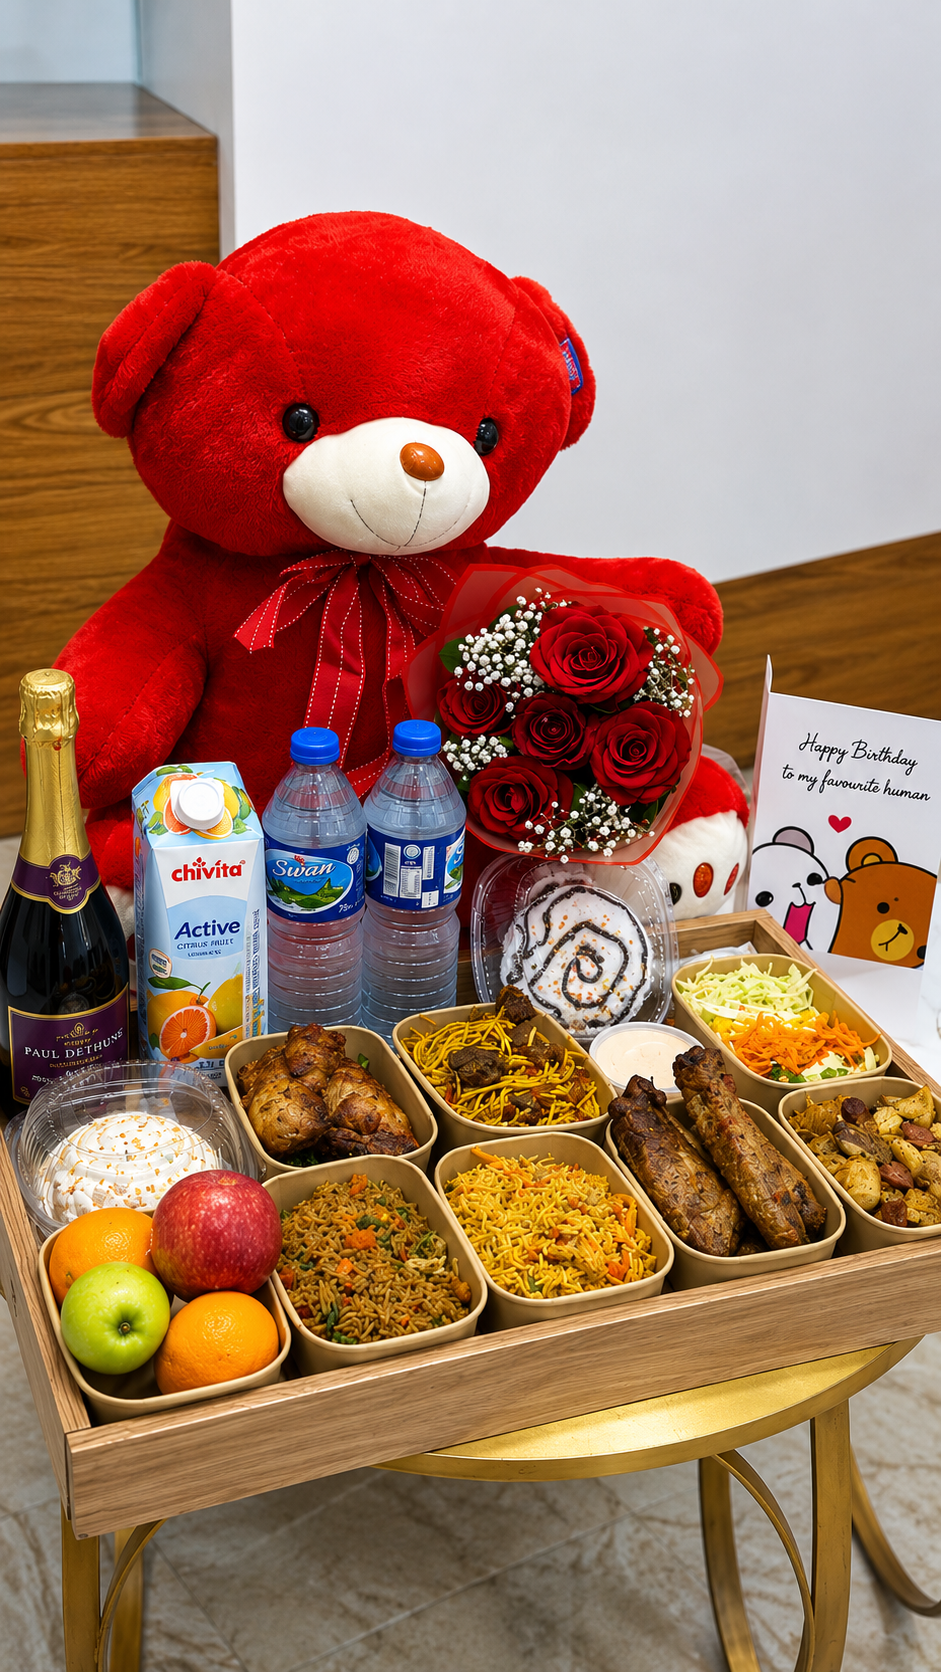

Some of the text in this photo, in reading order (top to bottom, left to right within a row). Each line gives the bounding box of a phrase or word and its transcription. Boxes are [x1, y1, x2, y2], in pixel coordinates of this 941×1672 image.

[799, 732, 918, 776] Happy Birthday
[782, 764, 930, 801] to my favourite human
[272, 859, 336, 877] Swan
[174, 919, 241, 940] Active
[24, 1046, 60, 1059] PAUL
